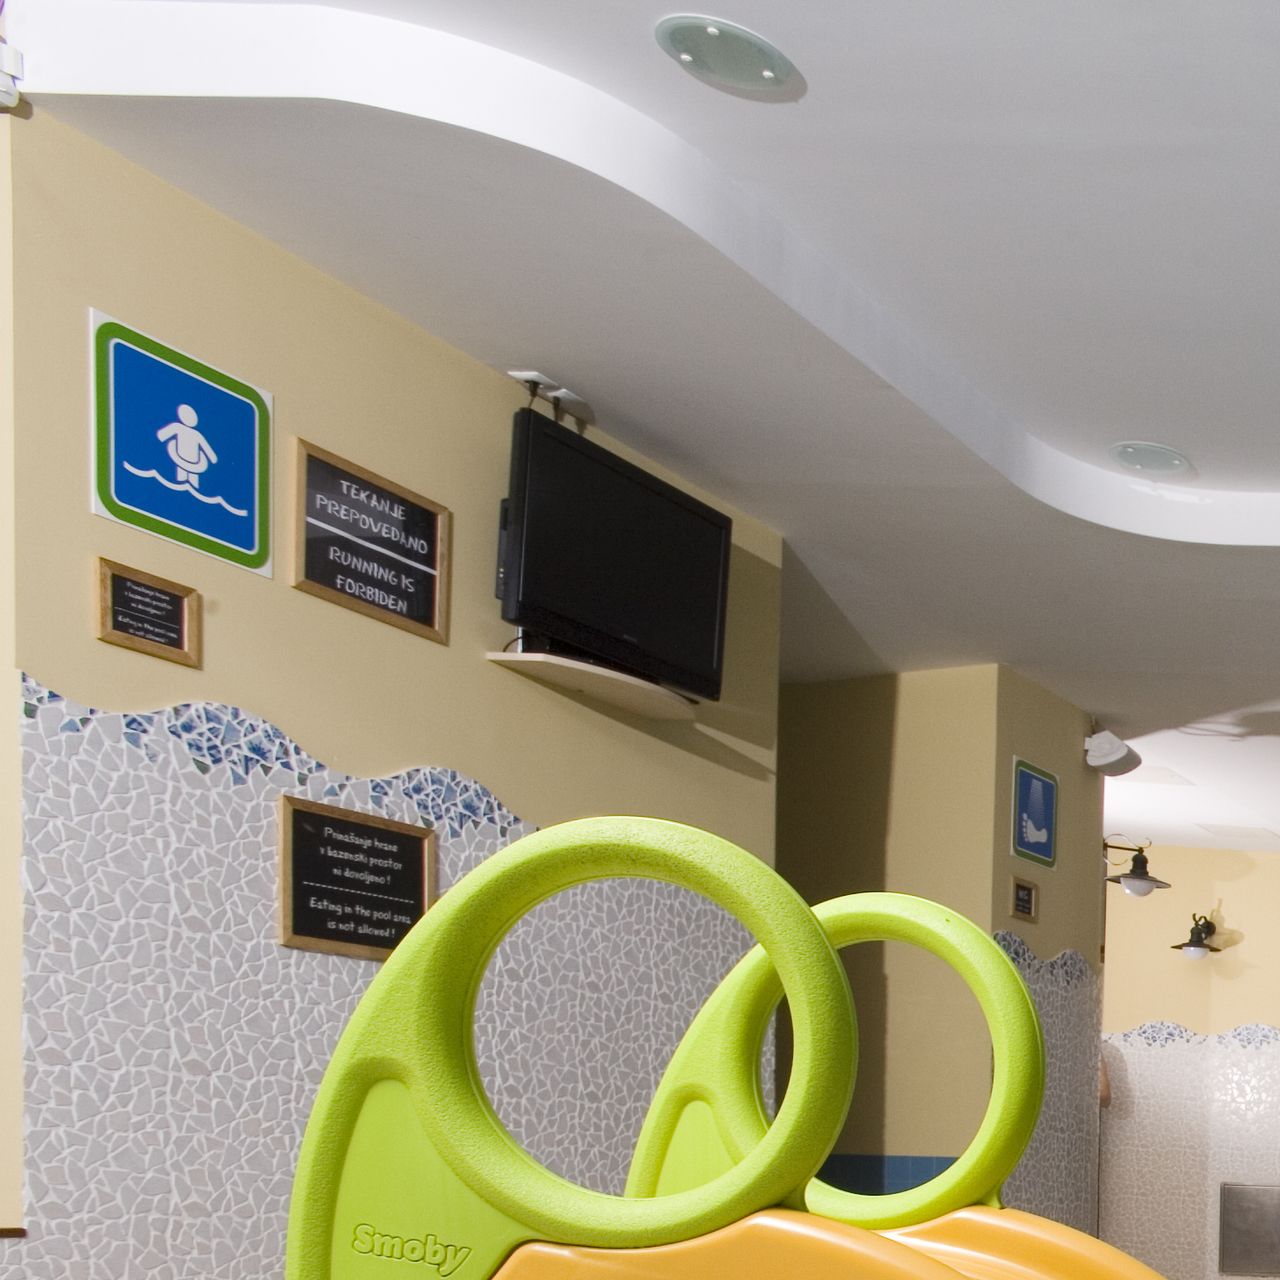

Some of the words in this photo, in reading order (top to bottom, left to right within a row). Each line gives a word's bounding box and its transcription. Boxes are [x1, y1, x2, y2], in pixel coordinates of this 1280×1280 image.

[340, 480, 406, 520] TEKANJE
[315, 494, 428, 554] PREPOVEDANO
[329, 546, 398, 585] RUNNING
[401, 574, 415, 592] IS
[336, 574, 407, 614] FORBIDEN
[343, 867, 385, 884] dovoljeno
[369, 858, 402, 870] prostor
[310, 897, 342, 915] Eating
[344, 903, 353, 914] in
[355, 905, 371, 917] the
[373, 911, 391, 922] pool
[327, 919, 337, 929] is
[338, 921, 355, 931] not
[357, 925, 390, 938] allowed
[352, 1223, 472, 1277] Smoby
